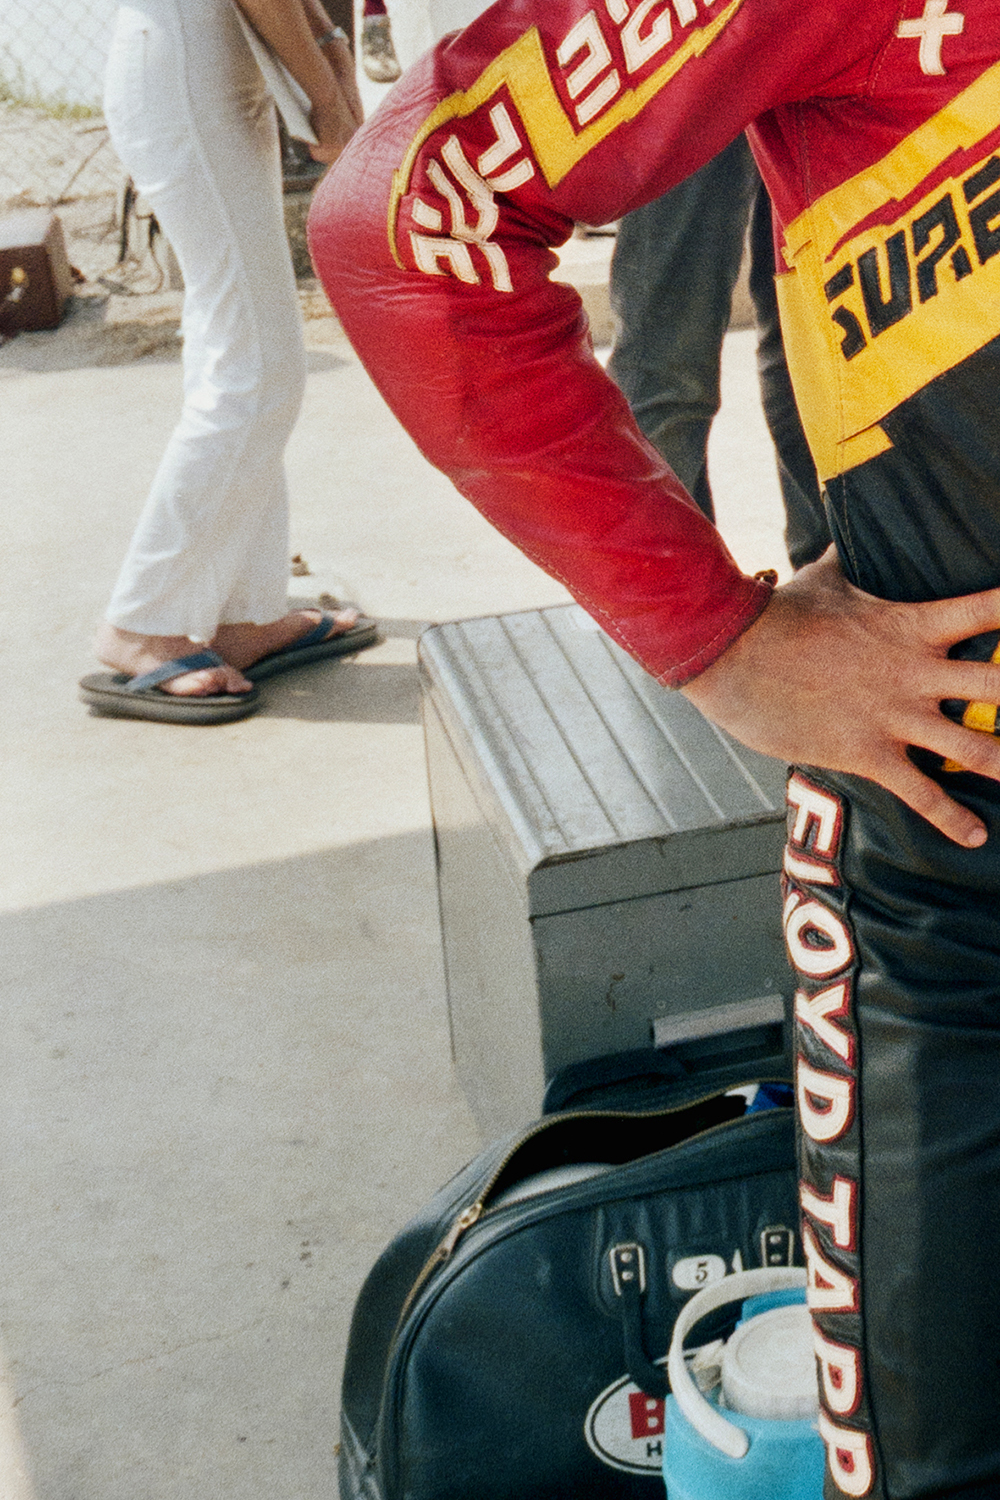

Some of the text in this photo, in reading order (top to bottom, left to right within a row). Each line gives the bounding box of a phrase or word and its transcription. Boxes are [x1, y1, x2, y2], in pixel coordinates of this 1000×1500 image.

[410, 102, 535, 292] FIRE
[695, 1260, 708, 1284] 5
[801, 1174, 875, 1498] TAPP
